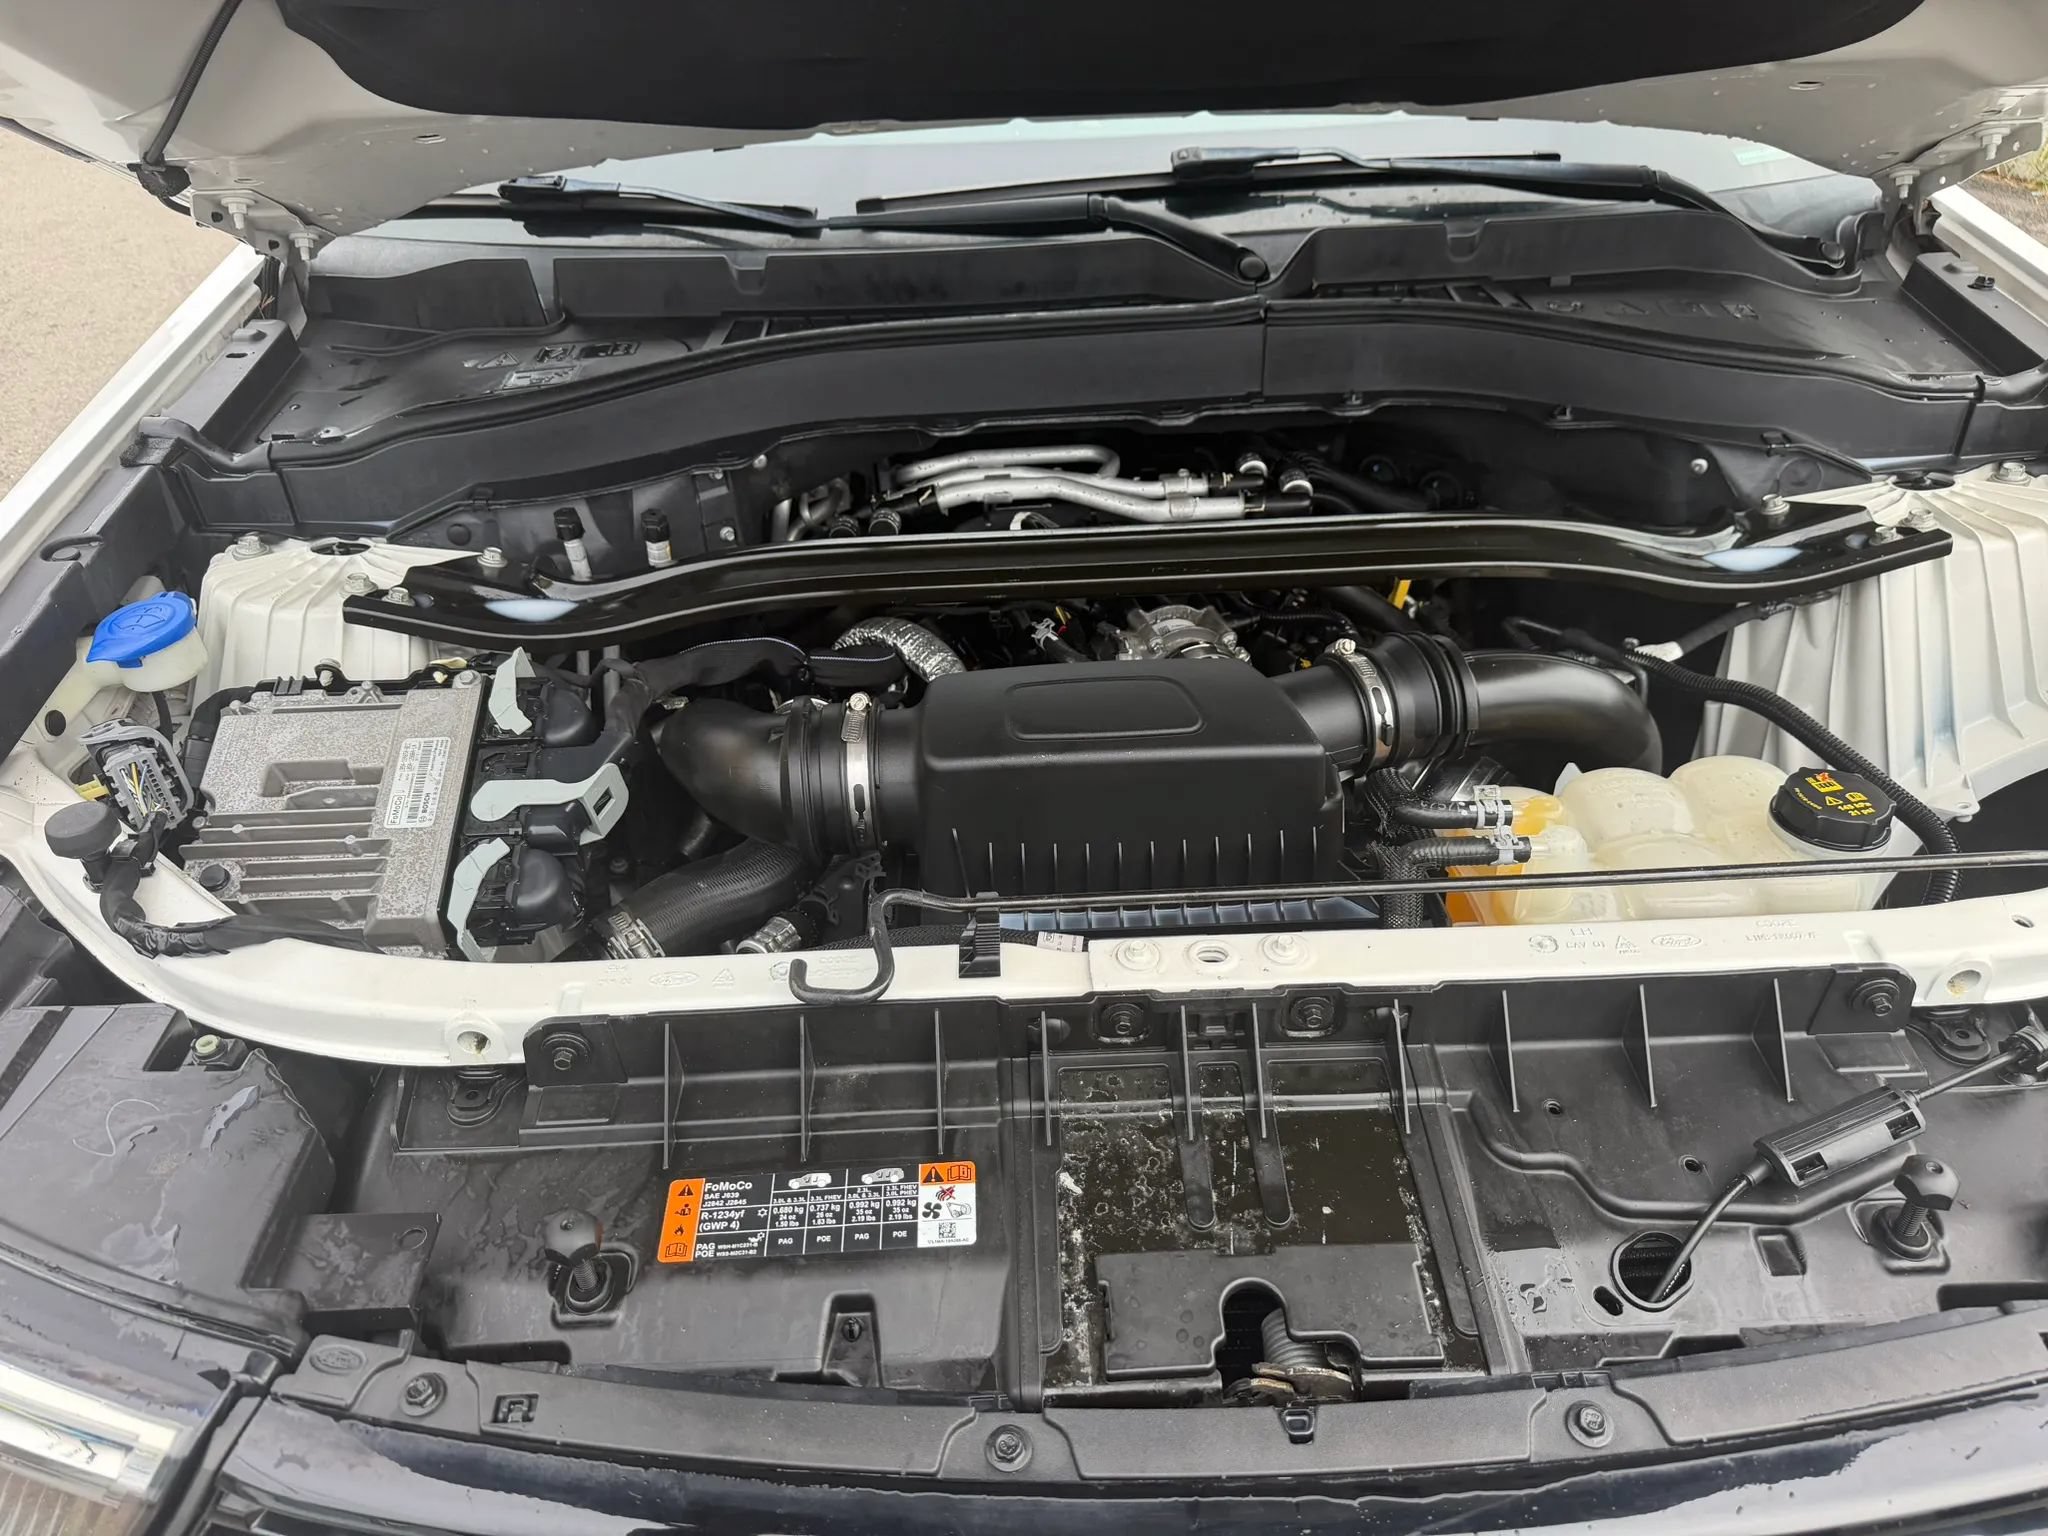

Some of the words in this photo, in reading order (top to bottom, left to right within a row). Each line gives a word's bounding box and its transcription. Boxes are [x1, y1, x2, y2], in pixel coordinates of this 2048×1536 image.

[421, 793, 431, 814] BOSCH
[391, 796, 403, 824] FoMoCo
[704, 1181, 753, 1192] FoMoCo
[848, 1201, 869, 1209] 0.992
[870, 1200, 880, 1209] kg
[885, 1199, 906, 1207] 0.992
[906, 1198, 917, 1207] kg
[773, 1206, 793, 1214] 0.680
[794, 1205, 804, 1214] kg
[809, 1203, 829, 1212] 0.737
[830, 1203, 841, 1212] kg
[701, 1209, 745, 1220] R-1234yf
[888, 1213, 902, 1221] 2.19
[699, 1221, 728, 1232] (GWP
[730, 1221, 740, 1230] 4)
[854, 1233, 870, 1241] PAG
[892, 1230, 908, 1238] POE
[778, 1237, 793, 1245] PAG
[816, 1235, 831, 1243] POE
[696, 1242, 716, 1251] PAG
[695, 1250, 715, 1258] POE
